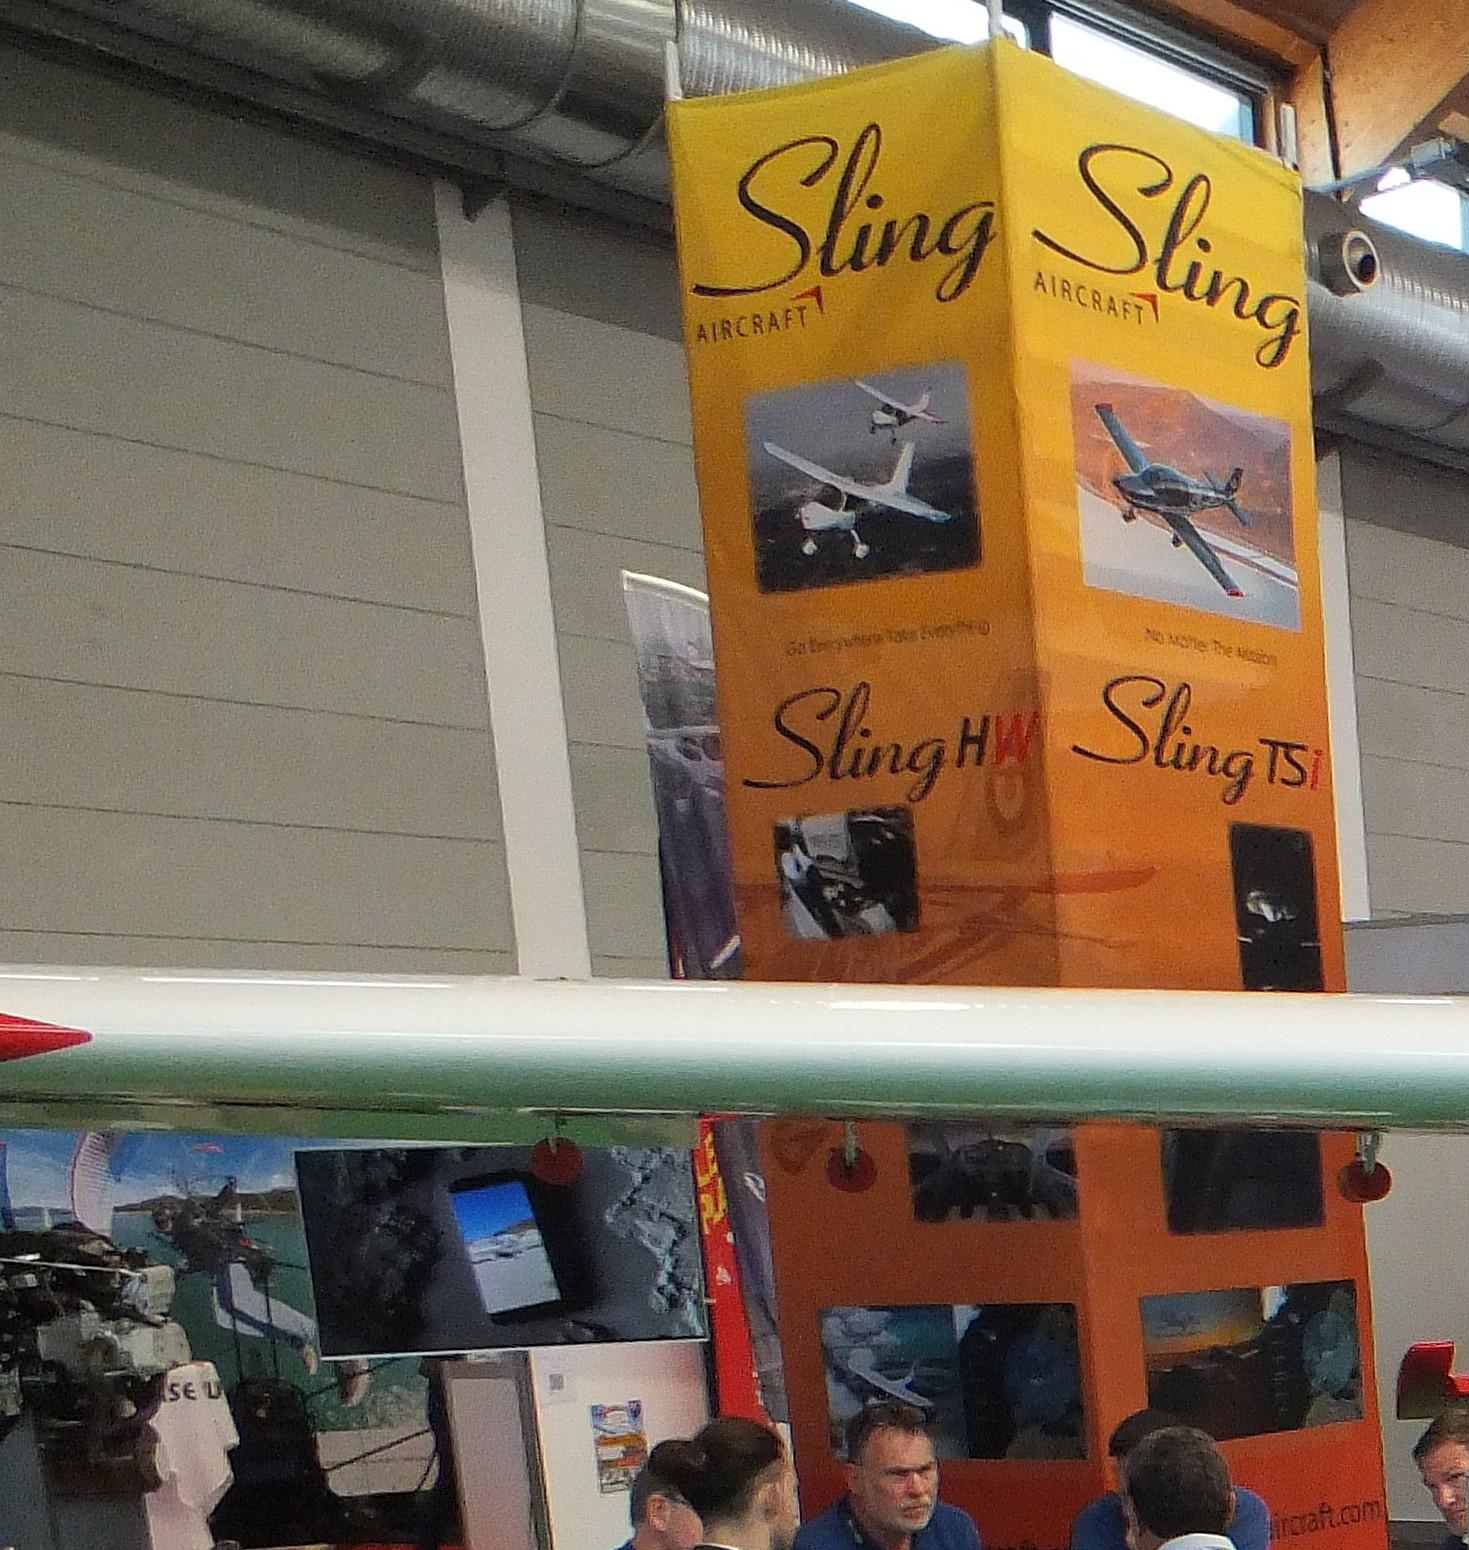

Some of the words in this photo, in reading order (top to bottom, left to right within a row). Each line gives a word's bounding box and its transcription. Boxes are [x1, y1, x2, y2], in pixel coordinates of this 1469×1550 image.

[690, 122, 998, 303] Sling
[1031, 142, 1301, 369] Sling
[696, 304, 807, 345] AIRCRAFT
[1033, 270, 1147, 326] AIRCRAFT
[743, 682, 946, 803] Sling
[1072, 675, 1256, 805] Sling
[1258, 737, 1324, 792] TSi
[1270, 1500, 1381, 1539] ircraft.com
